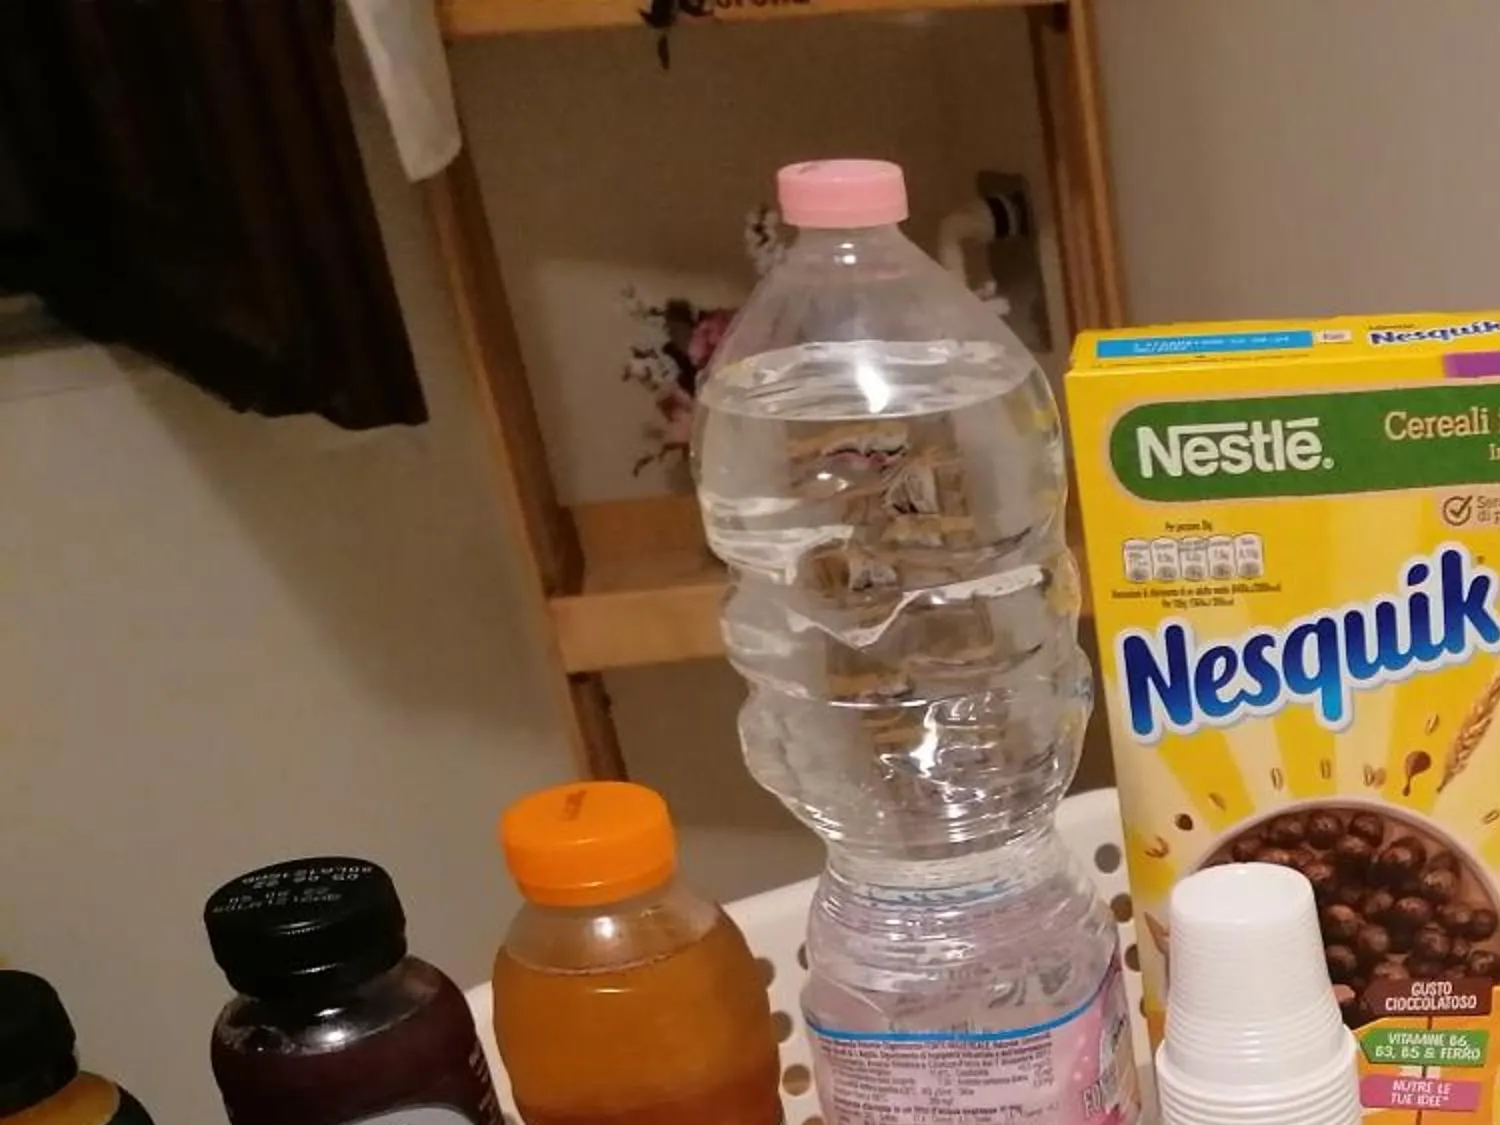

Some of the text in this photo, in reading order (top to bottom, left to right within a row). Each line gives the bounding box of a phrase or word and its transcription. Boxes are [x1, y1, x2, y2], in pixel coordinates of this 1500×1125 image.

[1384, 407, 1488, 440] Cereali
[1137, 417, 1324, 479] Nestlé
[1477, 508, 1490, 521] di
[1411, 981, 1453, 996] GUSTO
[1385, 995, 1478, 1011] CIOCCOLATOSO
[1388, 1032, 1445, 1046] VITAMINE
[1440, 1046, 1481, 1061] FERRO
